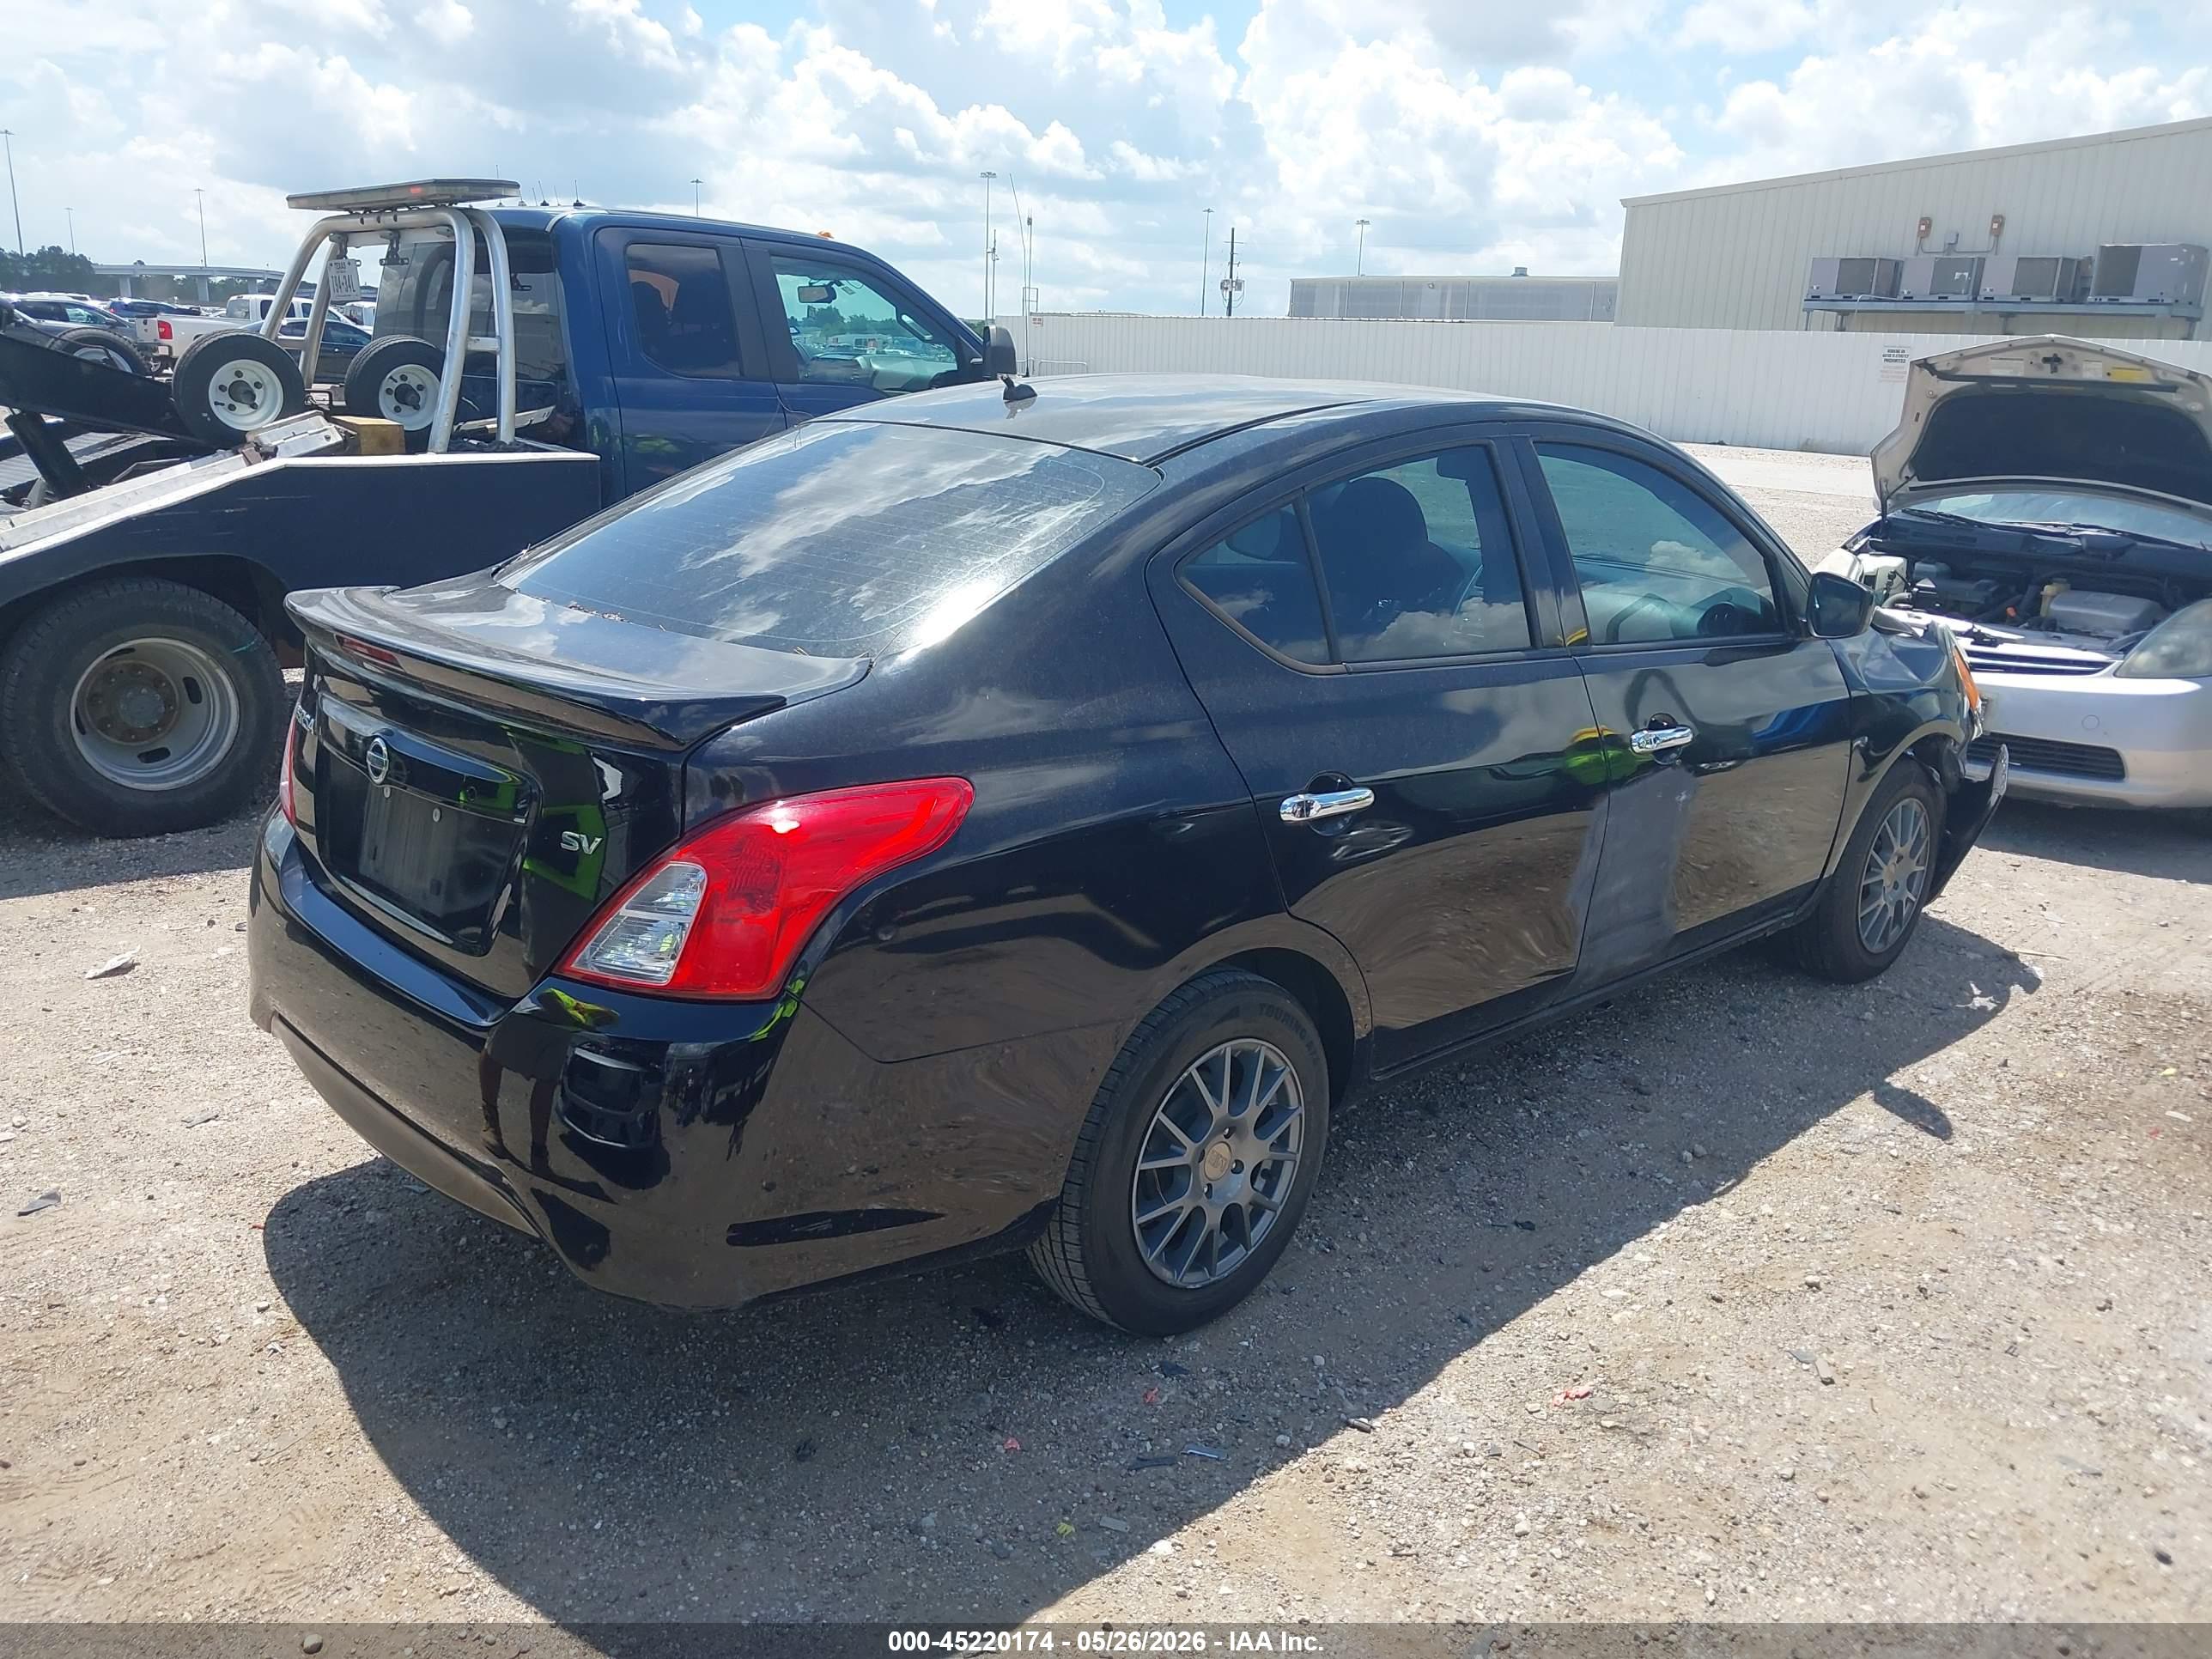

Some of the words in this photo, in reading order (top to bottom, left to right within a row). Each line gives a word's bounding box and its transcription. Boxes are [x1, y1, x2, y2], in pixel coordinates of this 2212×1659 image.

[334, 261, 346, 270] TEXAS
[560, 830, 603, 854] SV
[1258, 1003, 1308, 1040] TOURING
